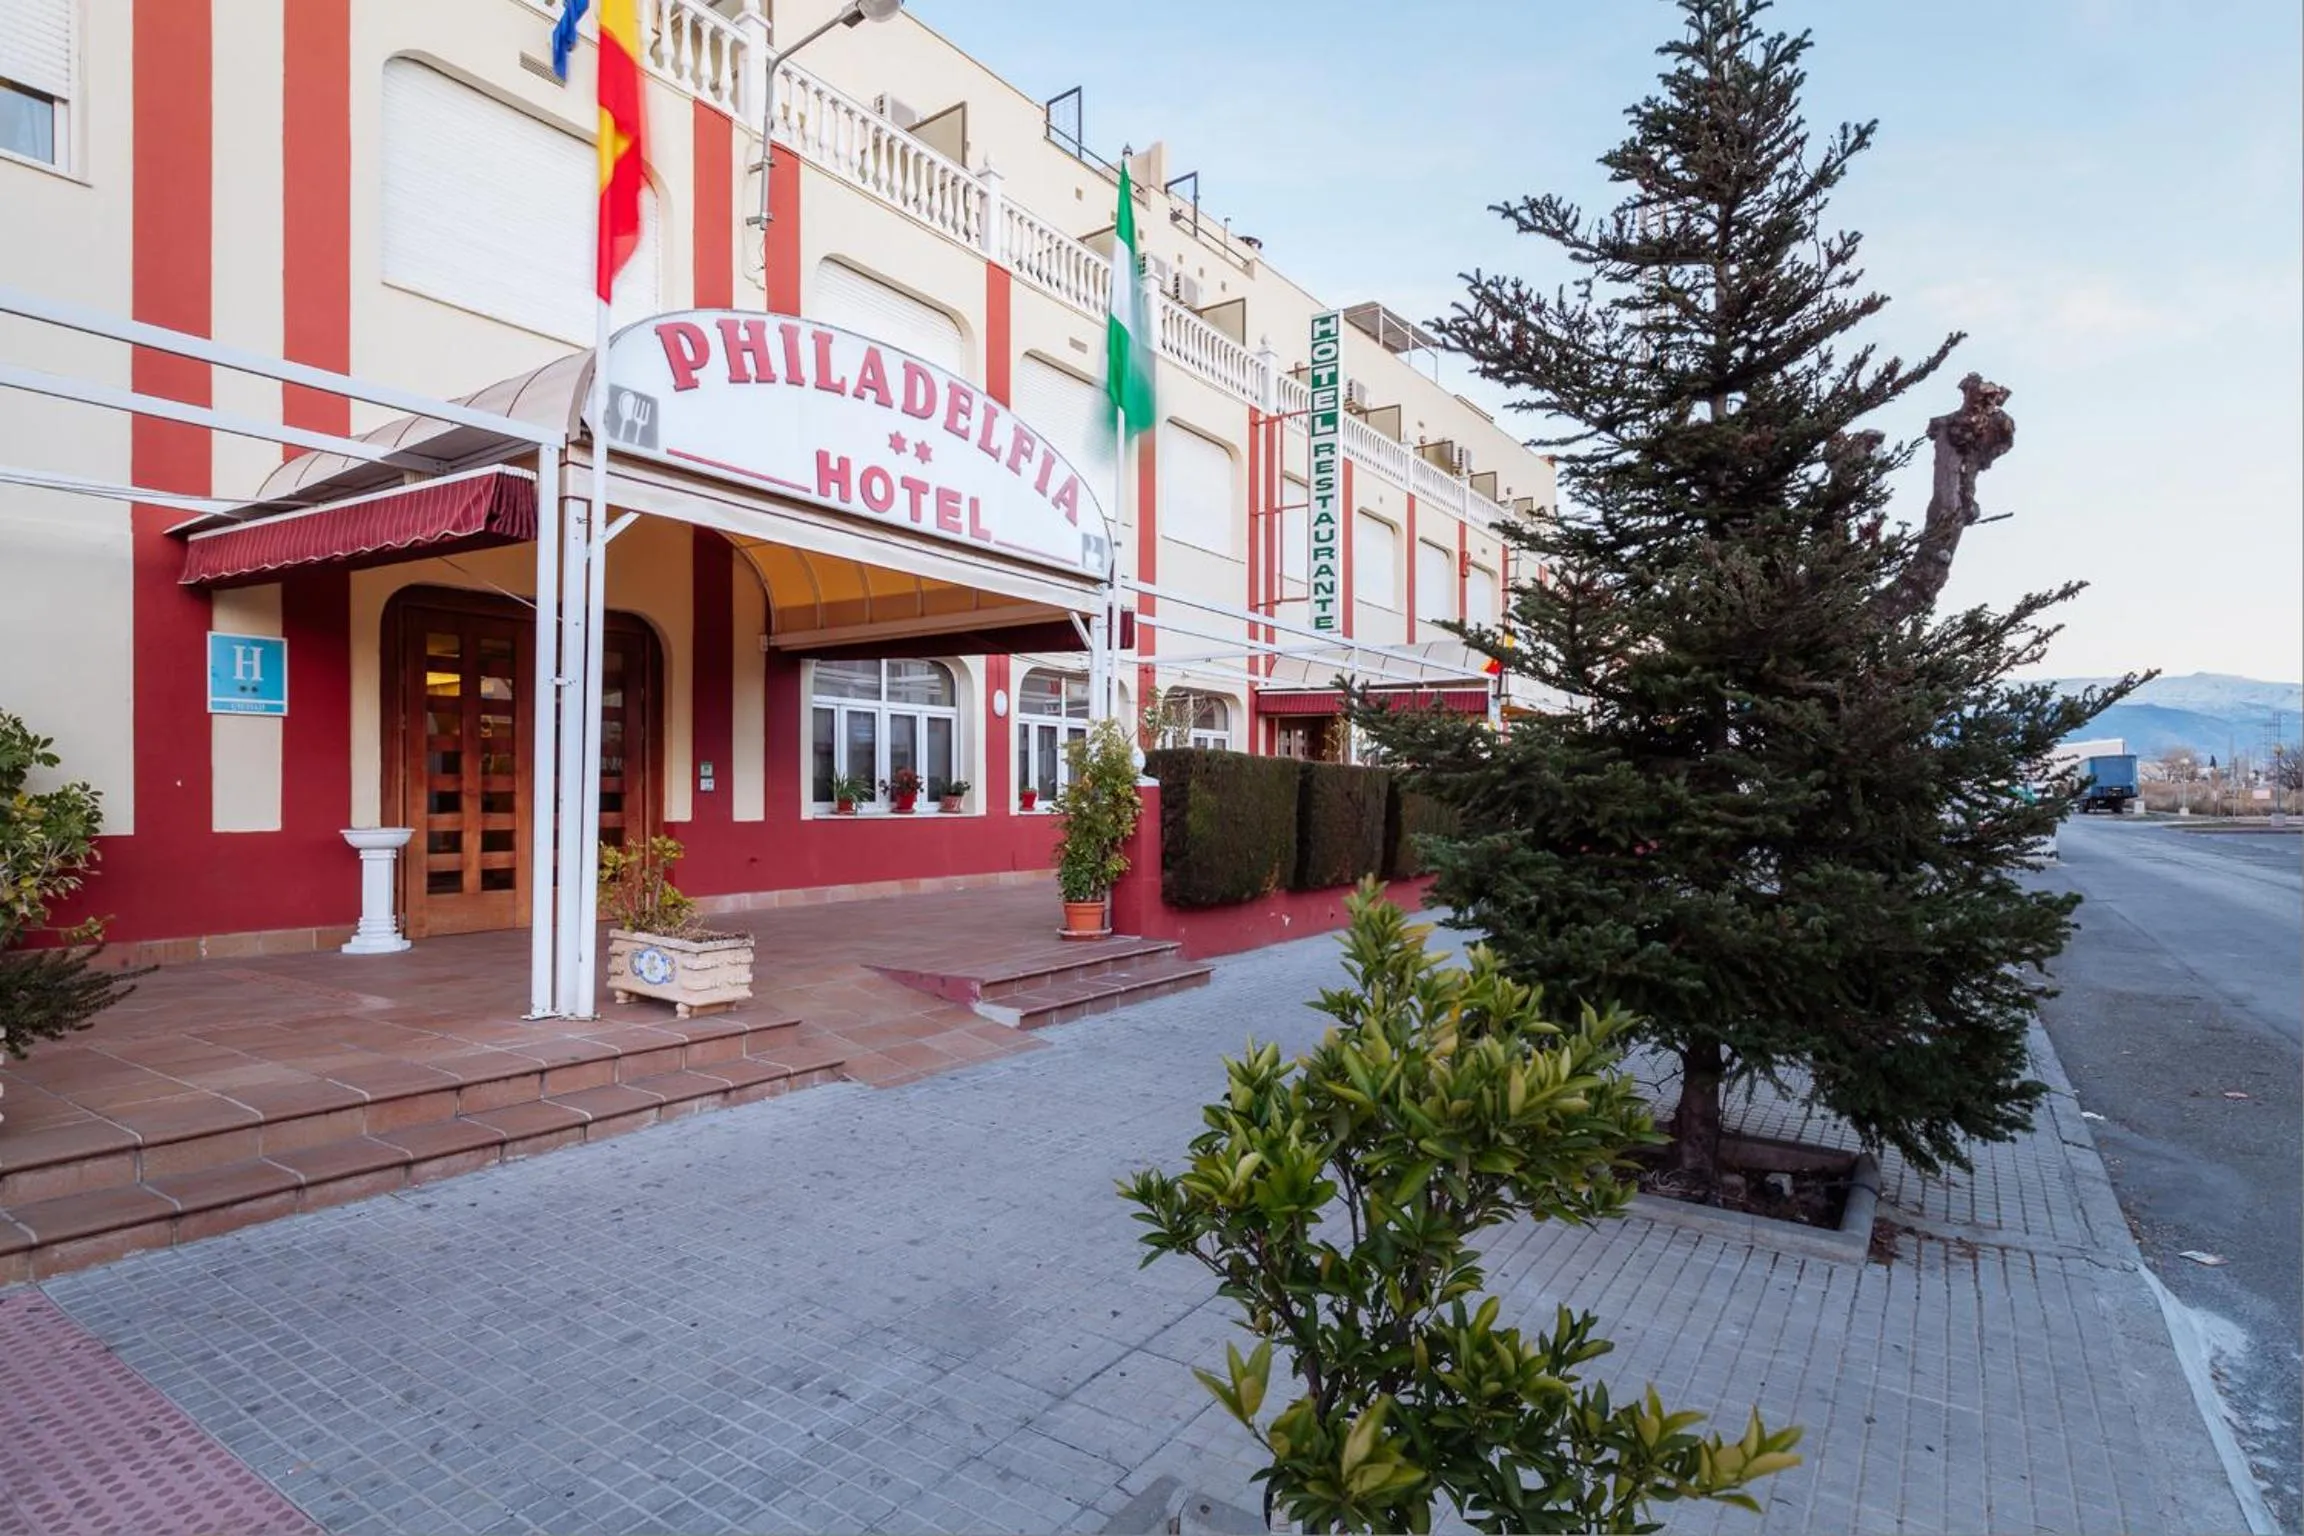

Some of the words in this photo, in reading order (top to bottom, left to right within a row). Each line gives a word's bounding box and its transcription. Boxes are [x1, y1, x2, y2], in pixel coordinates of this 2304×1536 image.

[655, 318, 1081, 527] PHILADELFIA
[1312, 317, 1339, 435] HOTEL
[816, 448, 992, 542] HOTEL
[1313, 442, 1335, 630] RESTAURANTE
[233, 645, 264, 681] H
